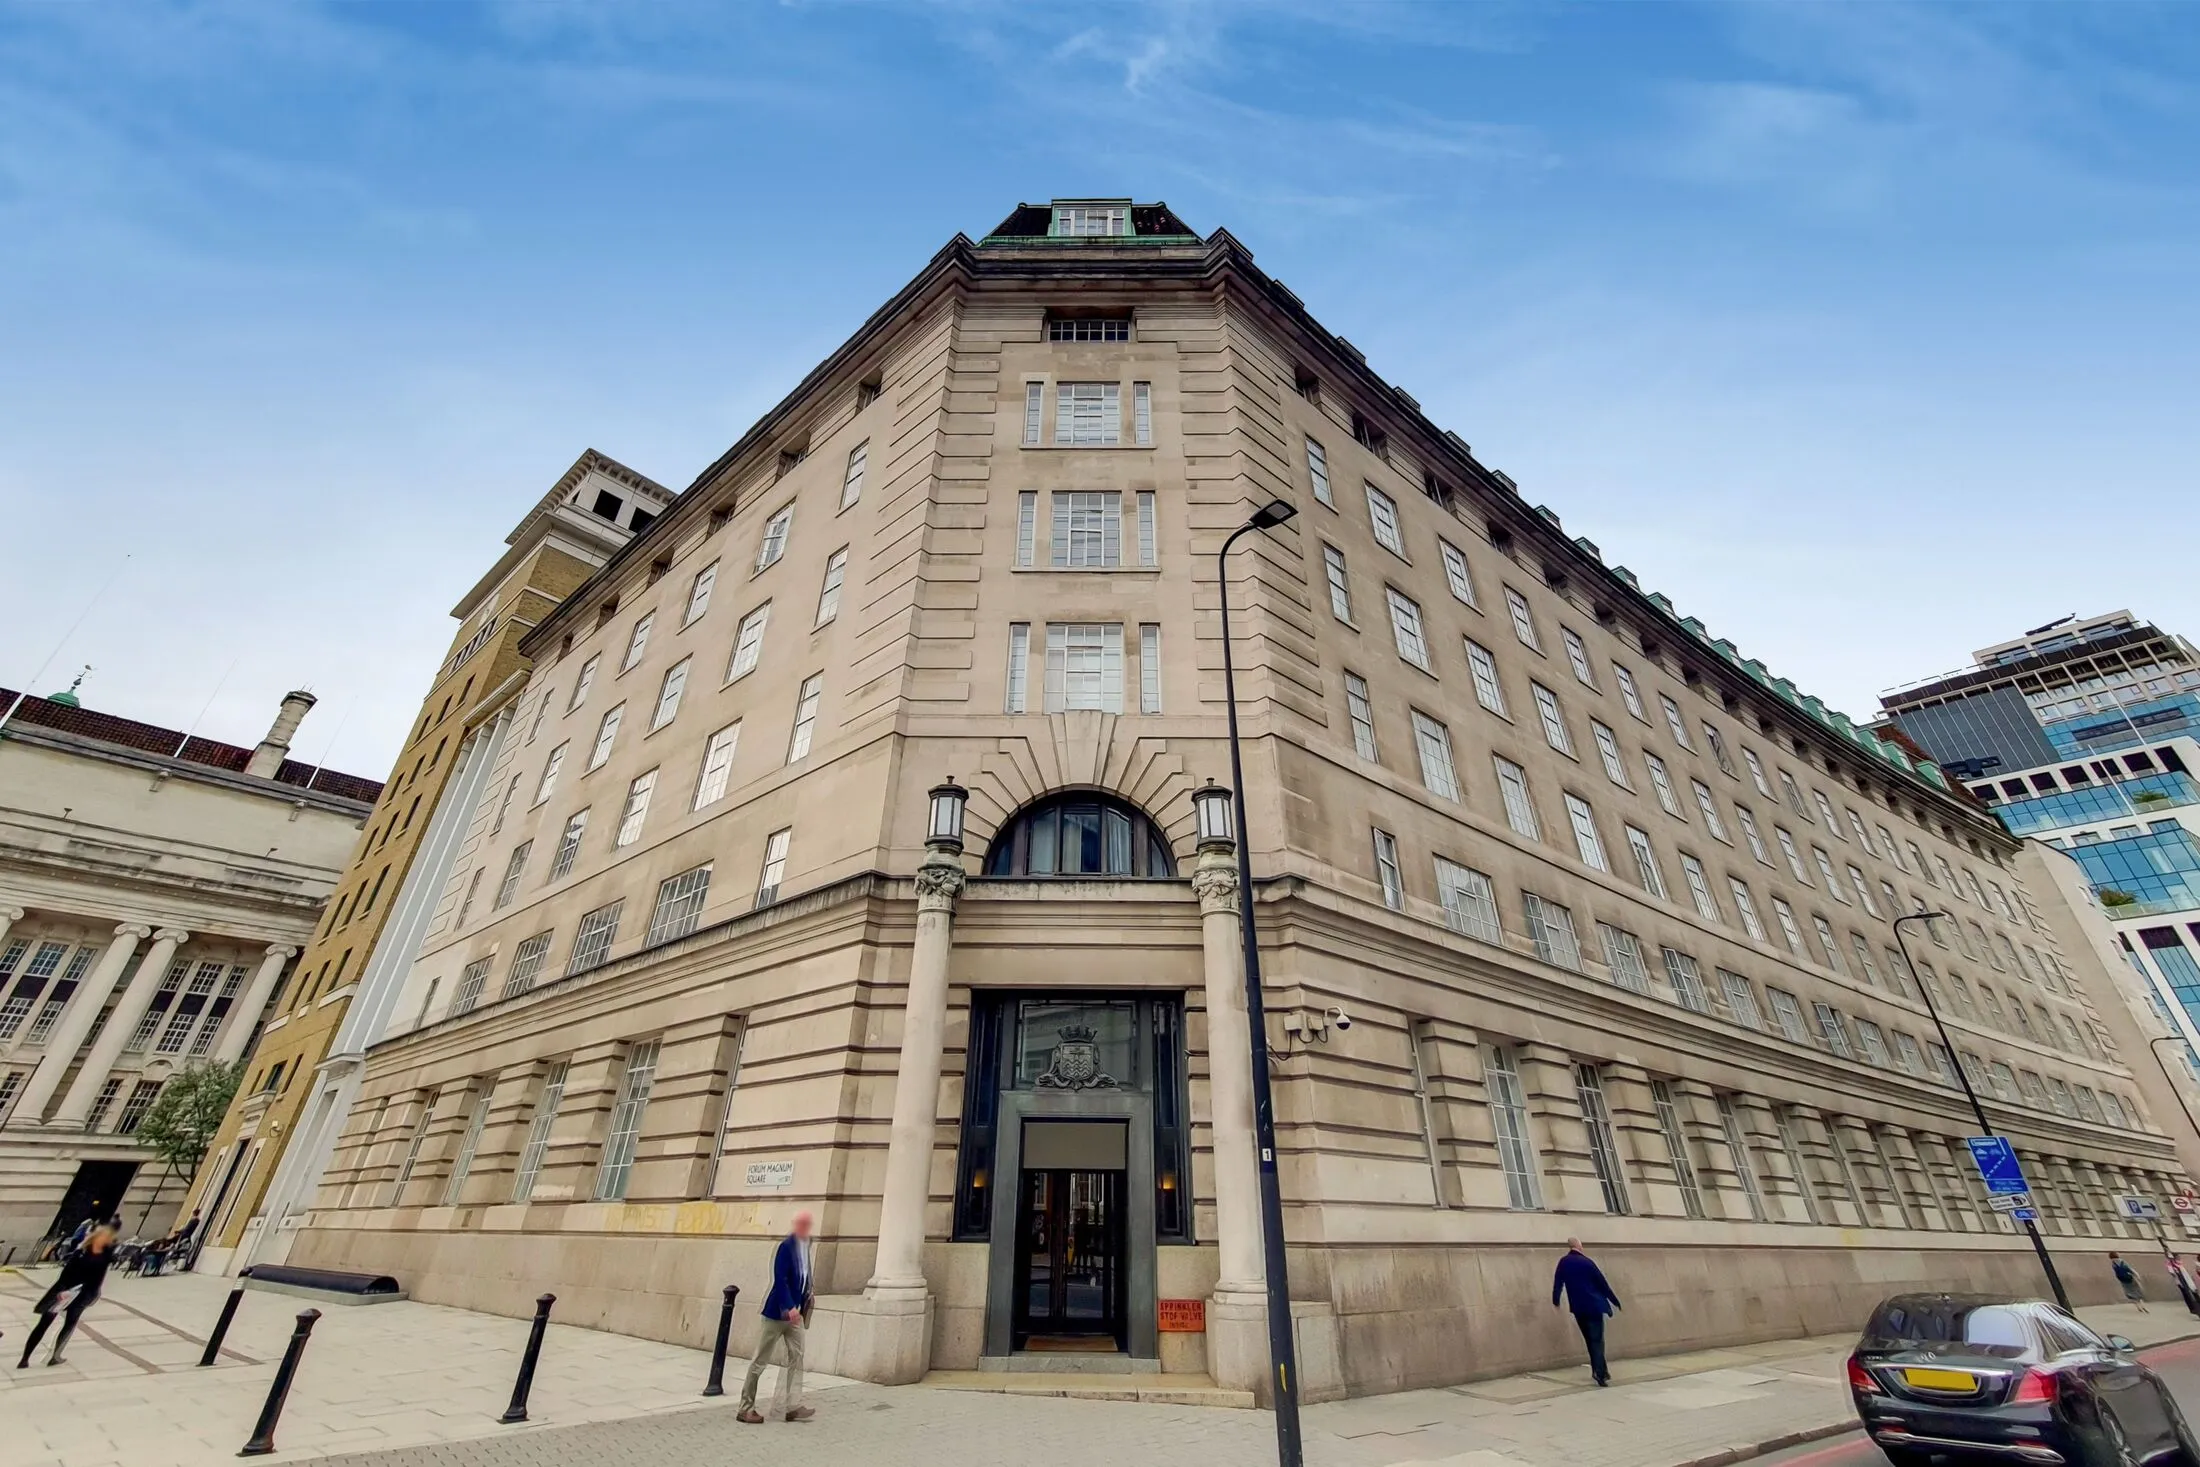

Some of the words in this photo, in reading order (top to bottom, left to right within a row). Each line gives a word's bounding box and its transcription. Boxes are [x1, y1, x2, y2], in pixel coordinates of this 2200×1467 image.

[748, 1164, 766, 1174] FORUM
[767, 1163, 792, 1173] MAGNUM
[746, 1174, 766, 1185] SQUARE
[1160, 1302, 1202, 1311] SPRINKLER
[1160, 1312, 1177, 1320] STOP
[1180, 1312, 1203, 1320] VALVE
